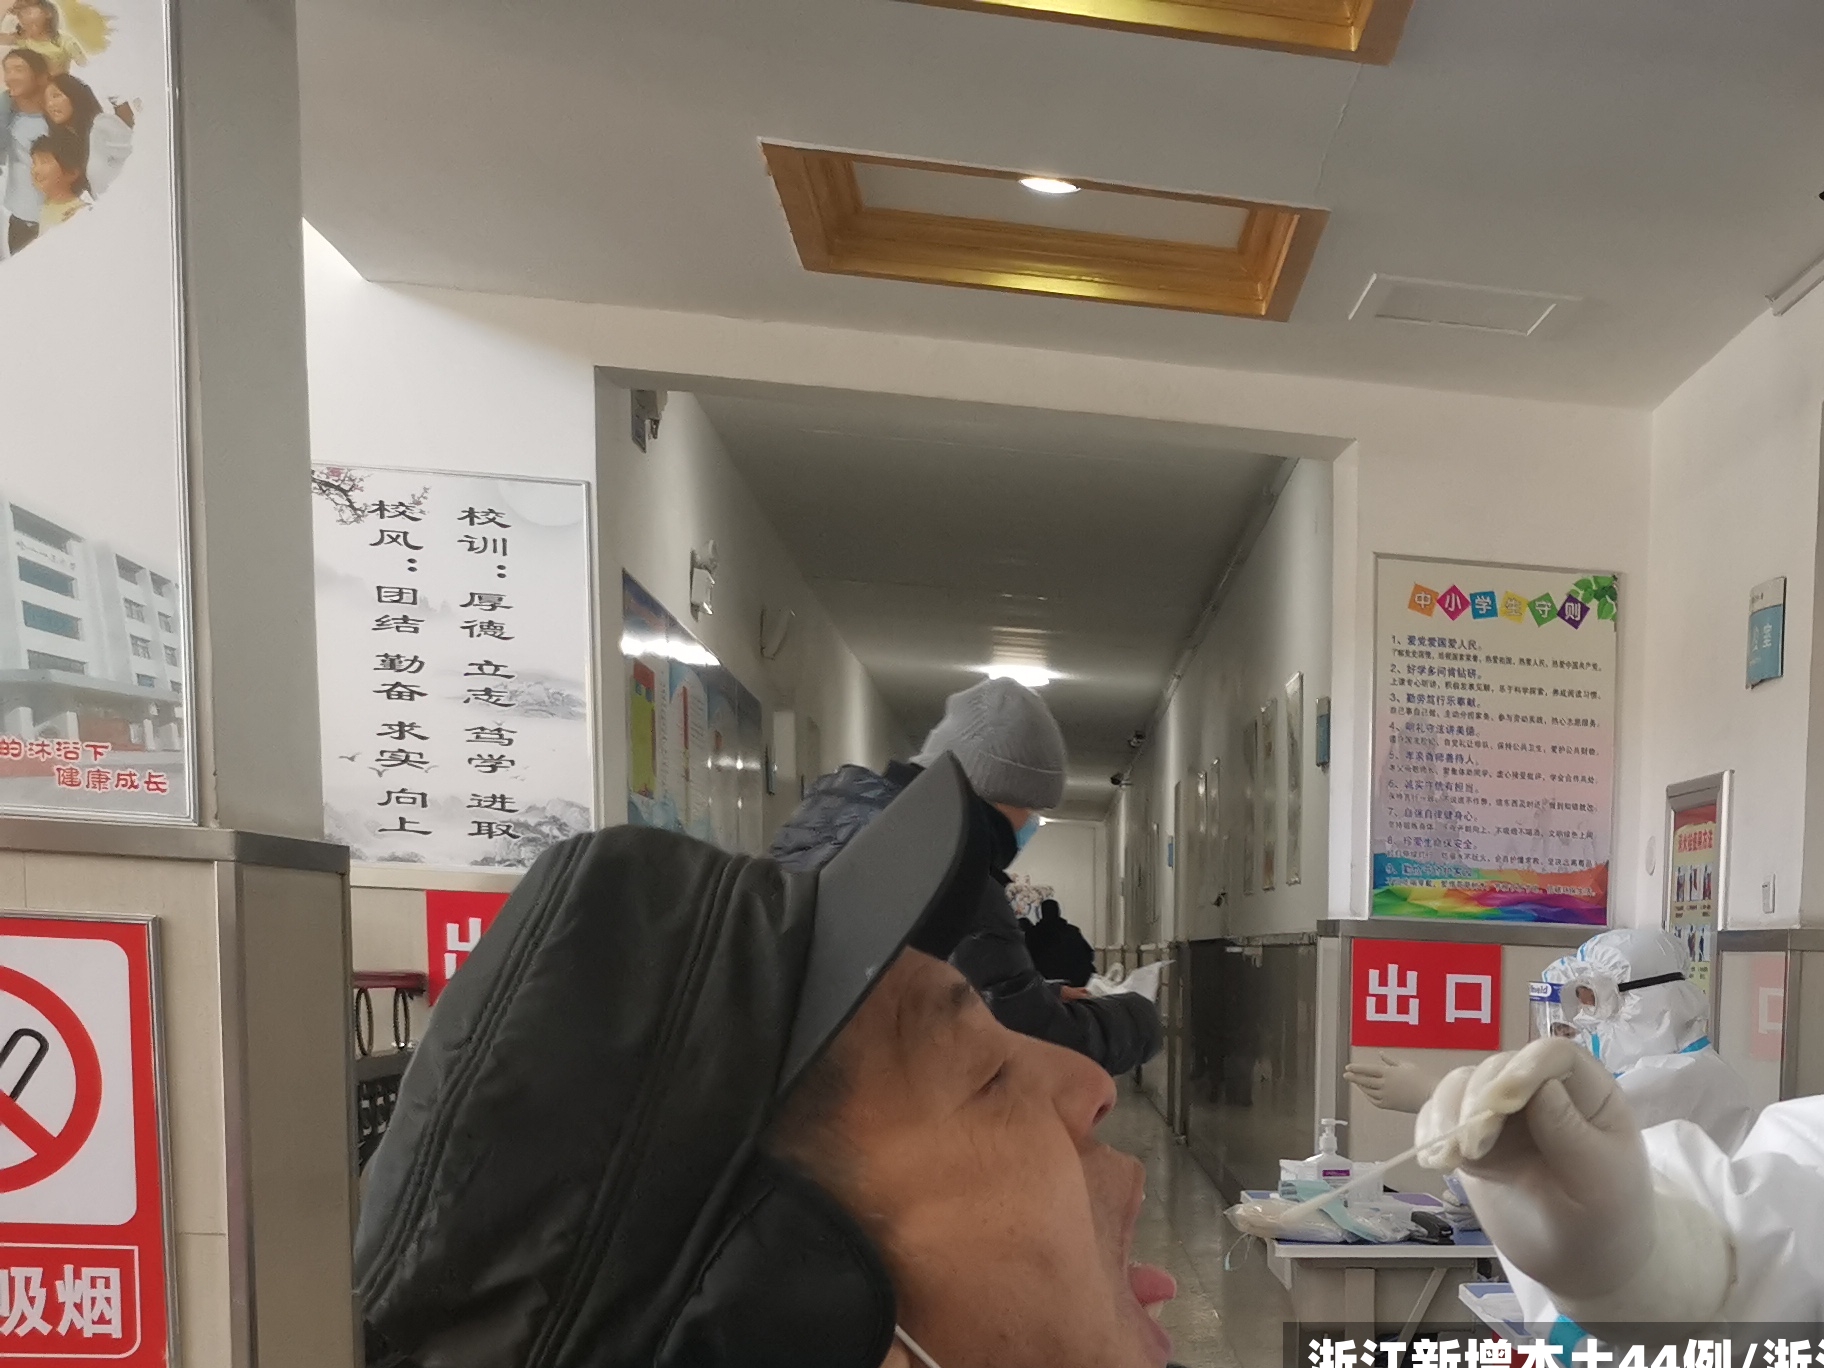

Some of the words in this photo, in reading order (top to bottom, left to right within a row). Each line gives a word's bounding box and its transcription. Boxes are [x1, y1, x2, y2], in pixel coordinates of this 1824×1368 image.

[1412, 591, 1590, 623] 中小学生守则
[0, 738, 111, 762] 的沐浴下
[56, 767, 169, 793] 健康成长
[1366, 963, 1492, 1025] 出口
[0, 1264, 123, 1340] 吸烟
